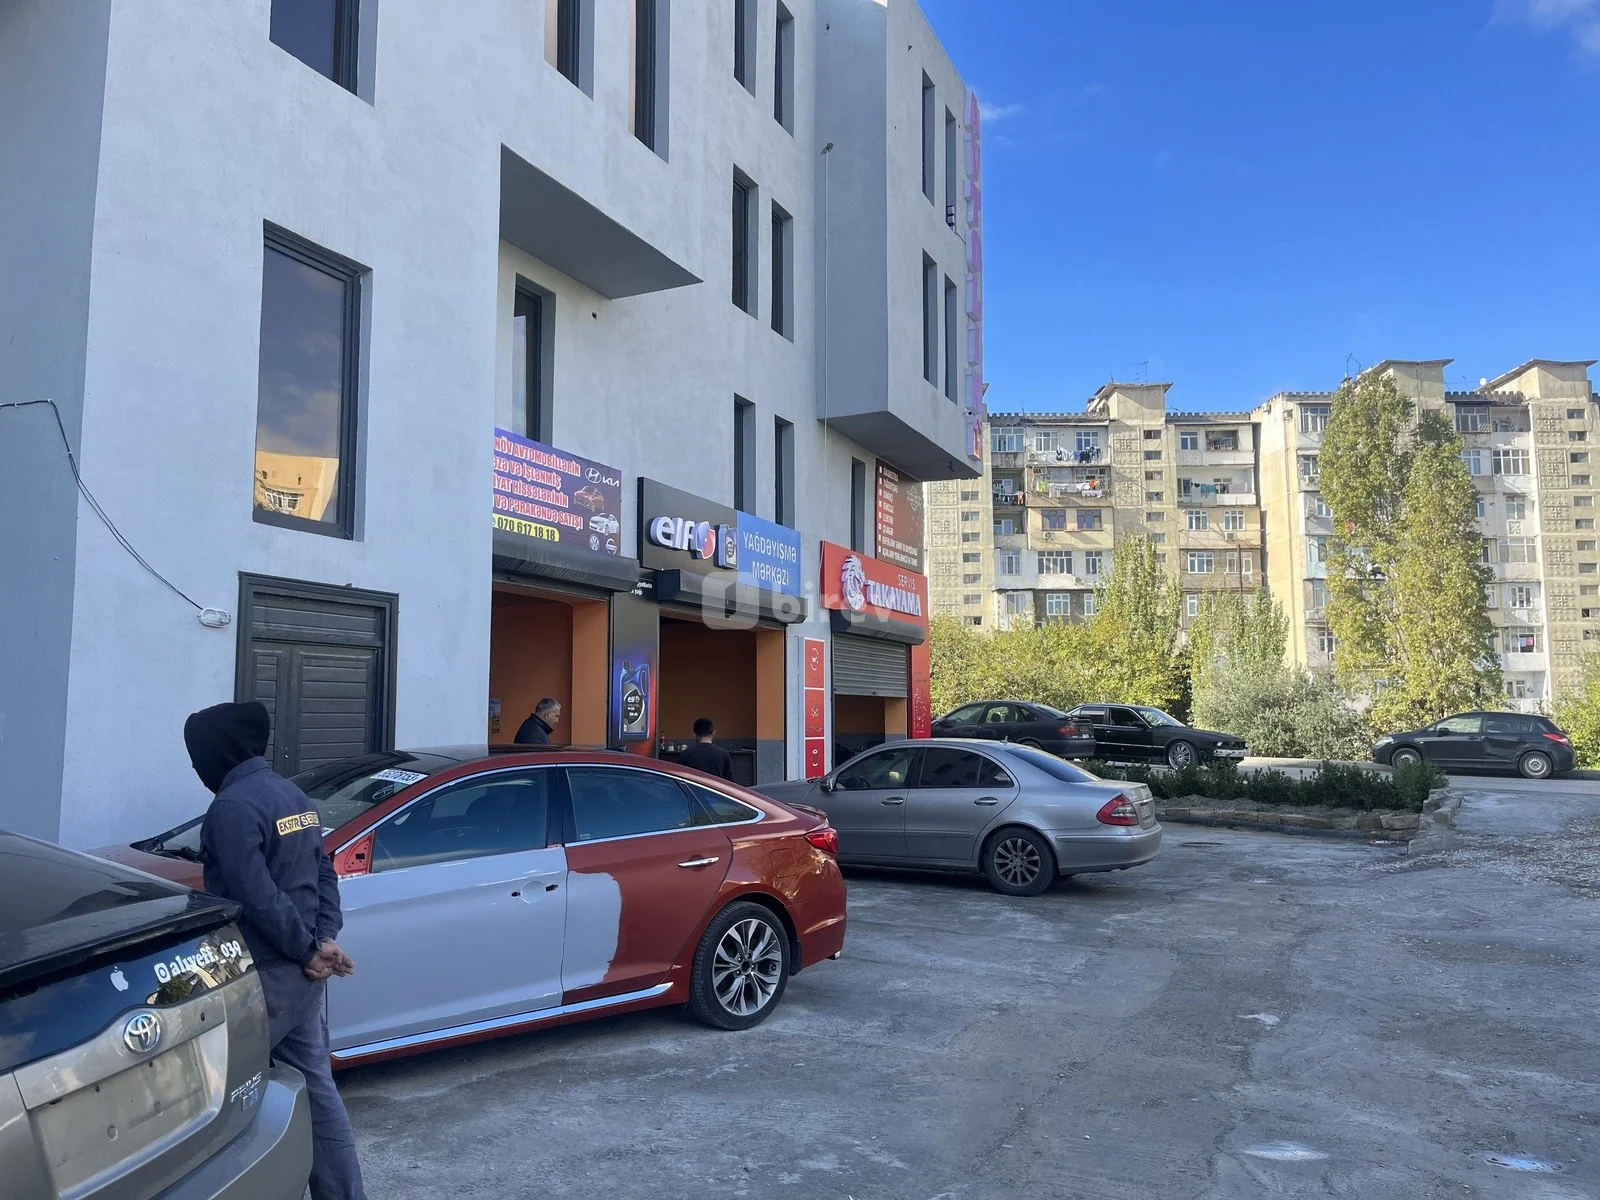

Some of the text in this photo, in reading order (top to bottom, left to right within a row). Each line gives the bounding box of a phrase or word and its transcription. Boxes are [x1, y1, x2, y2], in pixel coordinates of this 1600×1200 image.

[509, 460, 523, 476] VƏ
[522, 462, 562, 490] İŞLƏNMİŞ
[513, 442, 581, 478] AVTOMOBİLLƏRİN
[511, 479, 569, 508] HİSSƏLƏRİNİN
[497, 517, 556, 541] 070 617 18 18
[508, 497, 560, 524] PƏRAKƏNDƏ
[559, 510, 584, 531] SATIŞI
[650, 516, 694, 551] elf
[742, 530, 798, 564] YAĞDƏYİŞMƏ
[751, 560, 790, 587] MƏRKƏZİ
[864, 580, 923, 616] TAKAYAMA
